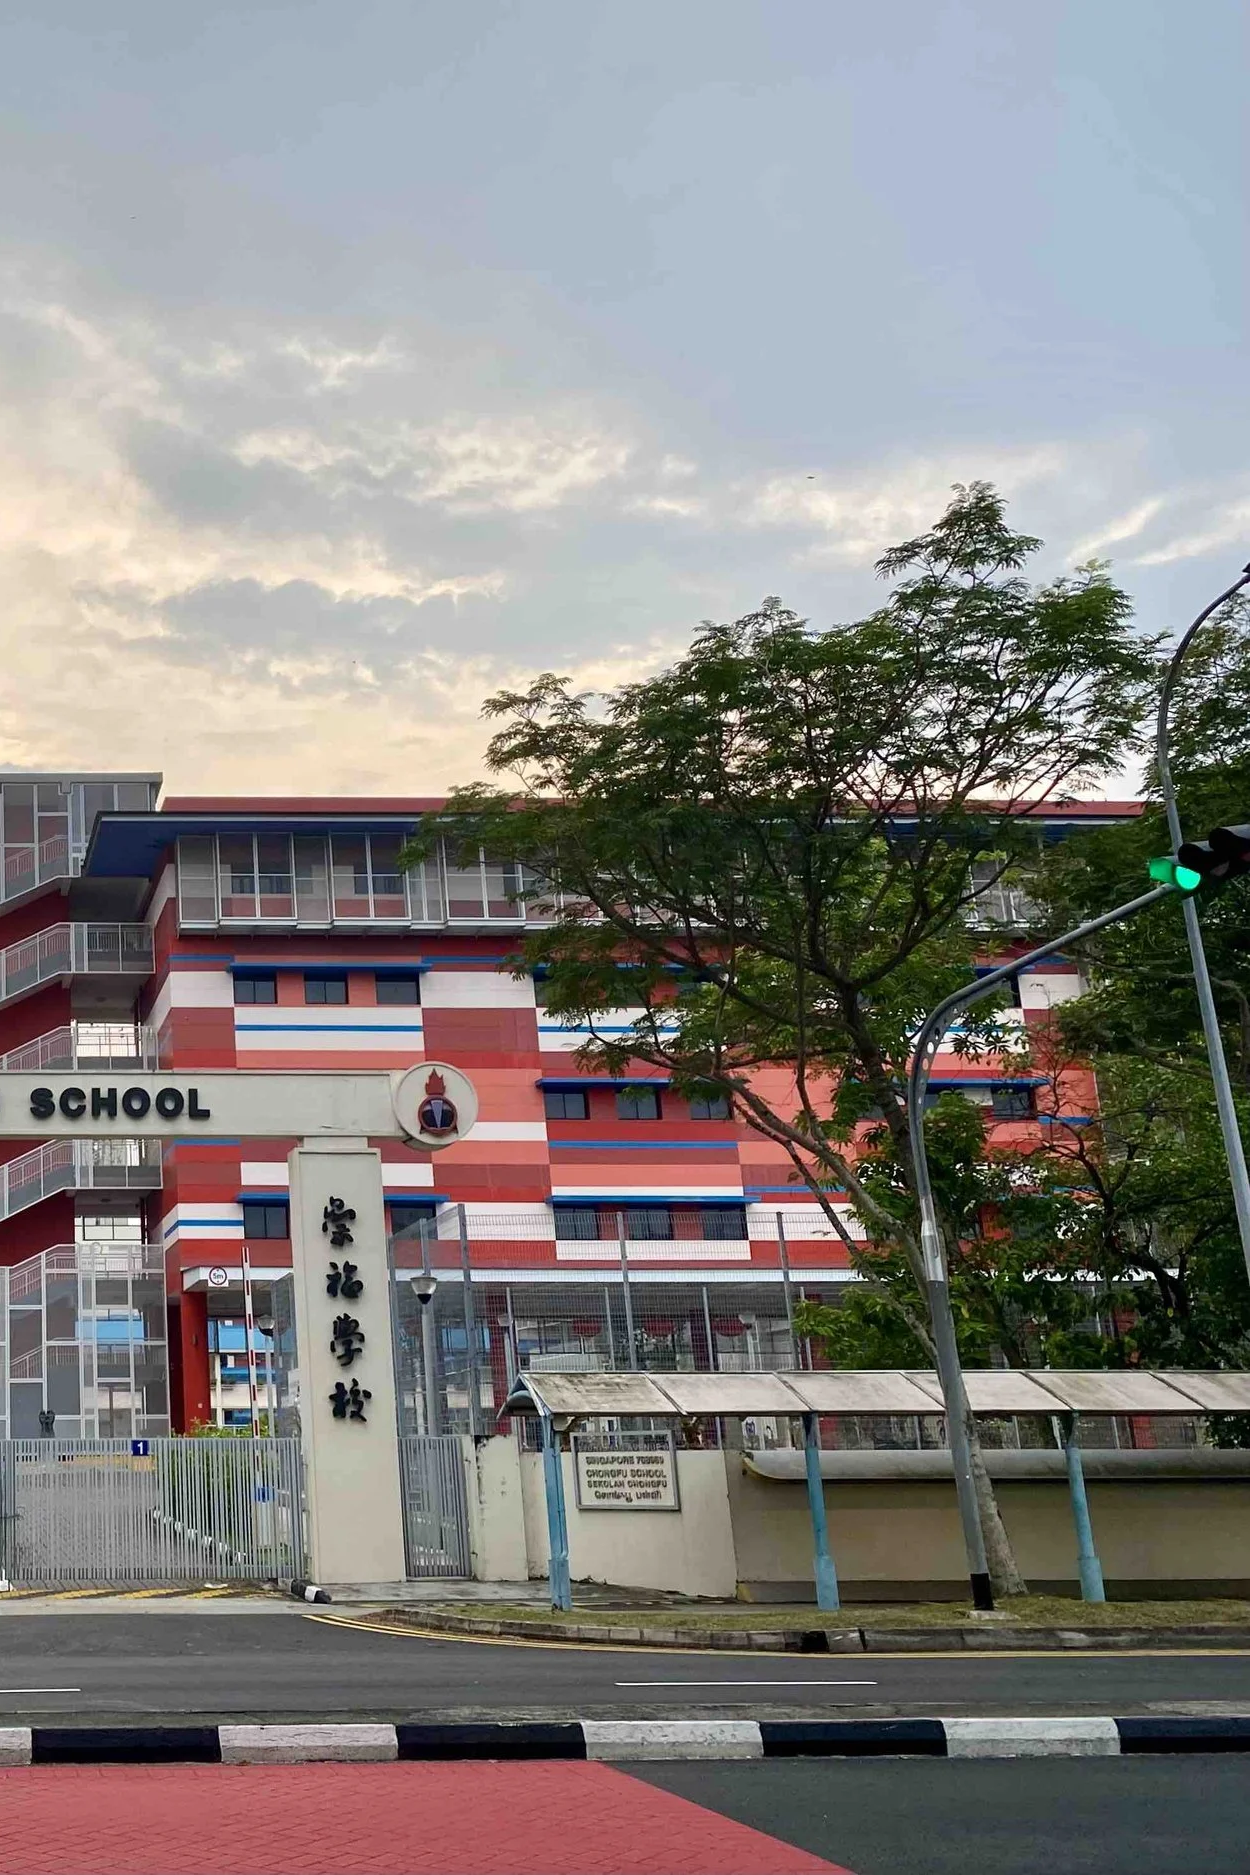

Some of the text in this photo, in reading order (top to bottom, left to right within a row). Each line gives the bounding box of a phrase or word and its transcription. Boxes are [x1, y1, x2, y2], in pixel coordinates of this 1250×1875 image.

[29, 1086, 211, 1121] SCHOOL
[137, 1441, 144, 1455] 1
[585, 1456, 635, 1465] SINGAPORE
[586, 1469, 667, 1478] CHONGFU SCHOOL
[587, 1480, 668, 1488] SEKOLAH CHONGFU
